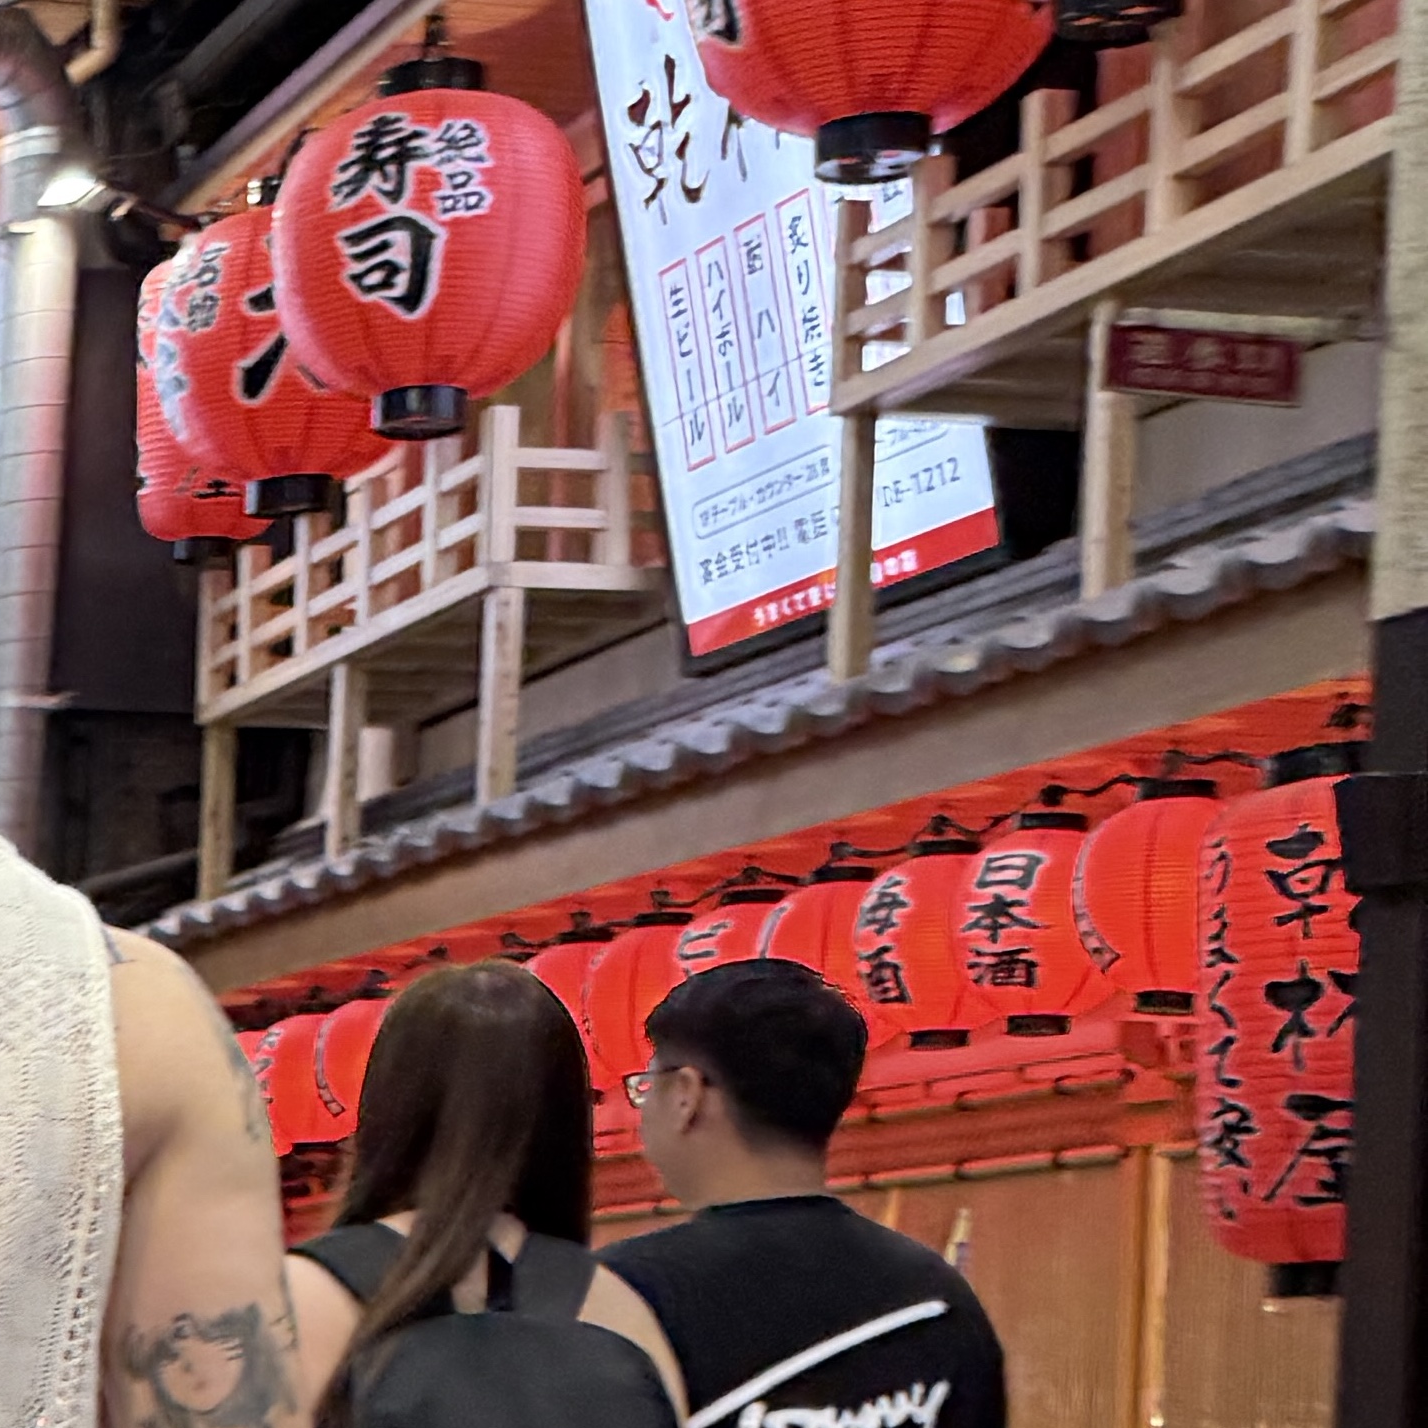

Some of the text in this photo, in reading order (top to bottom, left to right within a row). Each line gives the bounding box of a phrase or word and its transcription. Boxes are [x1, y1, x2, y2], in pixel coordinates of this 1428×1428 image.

[330, 114, 447, 320] 寿司
[435, 120, 489, 217] 絶品
[706, 260, 745, 428] ハイボール
[960, 850, 1053, 988] 日本酒
